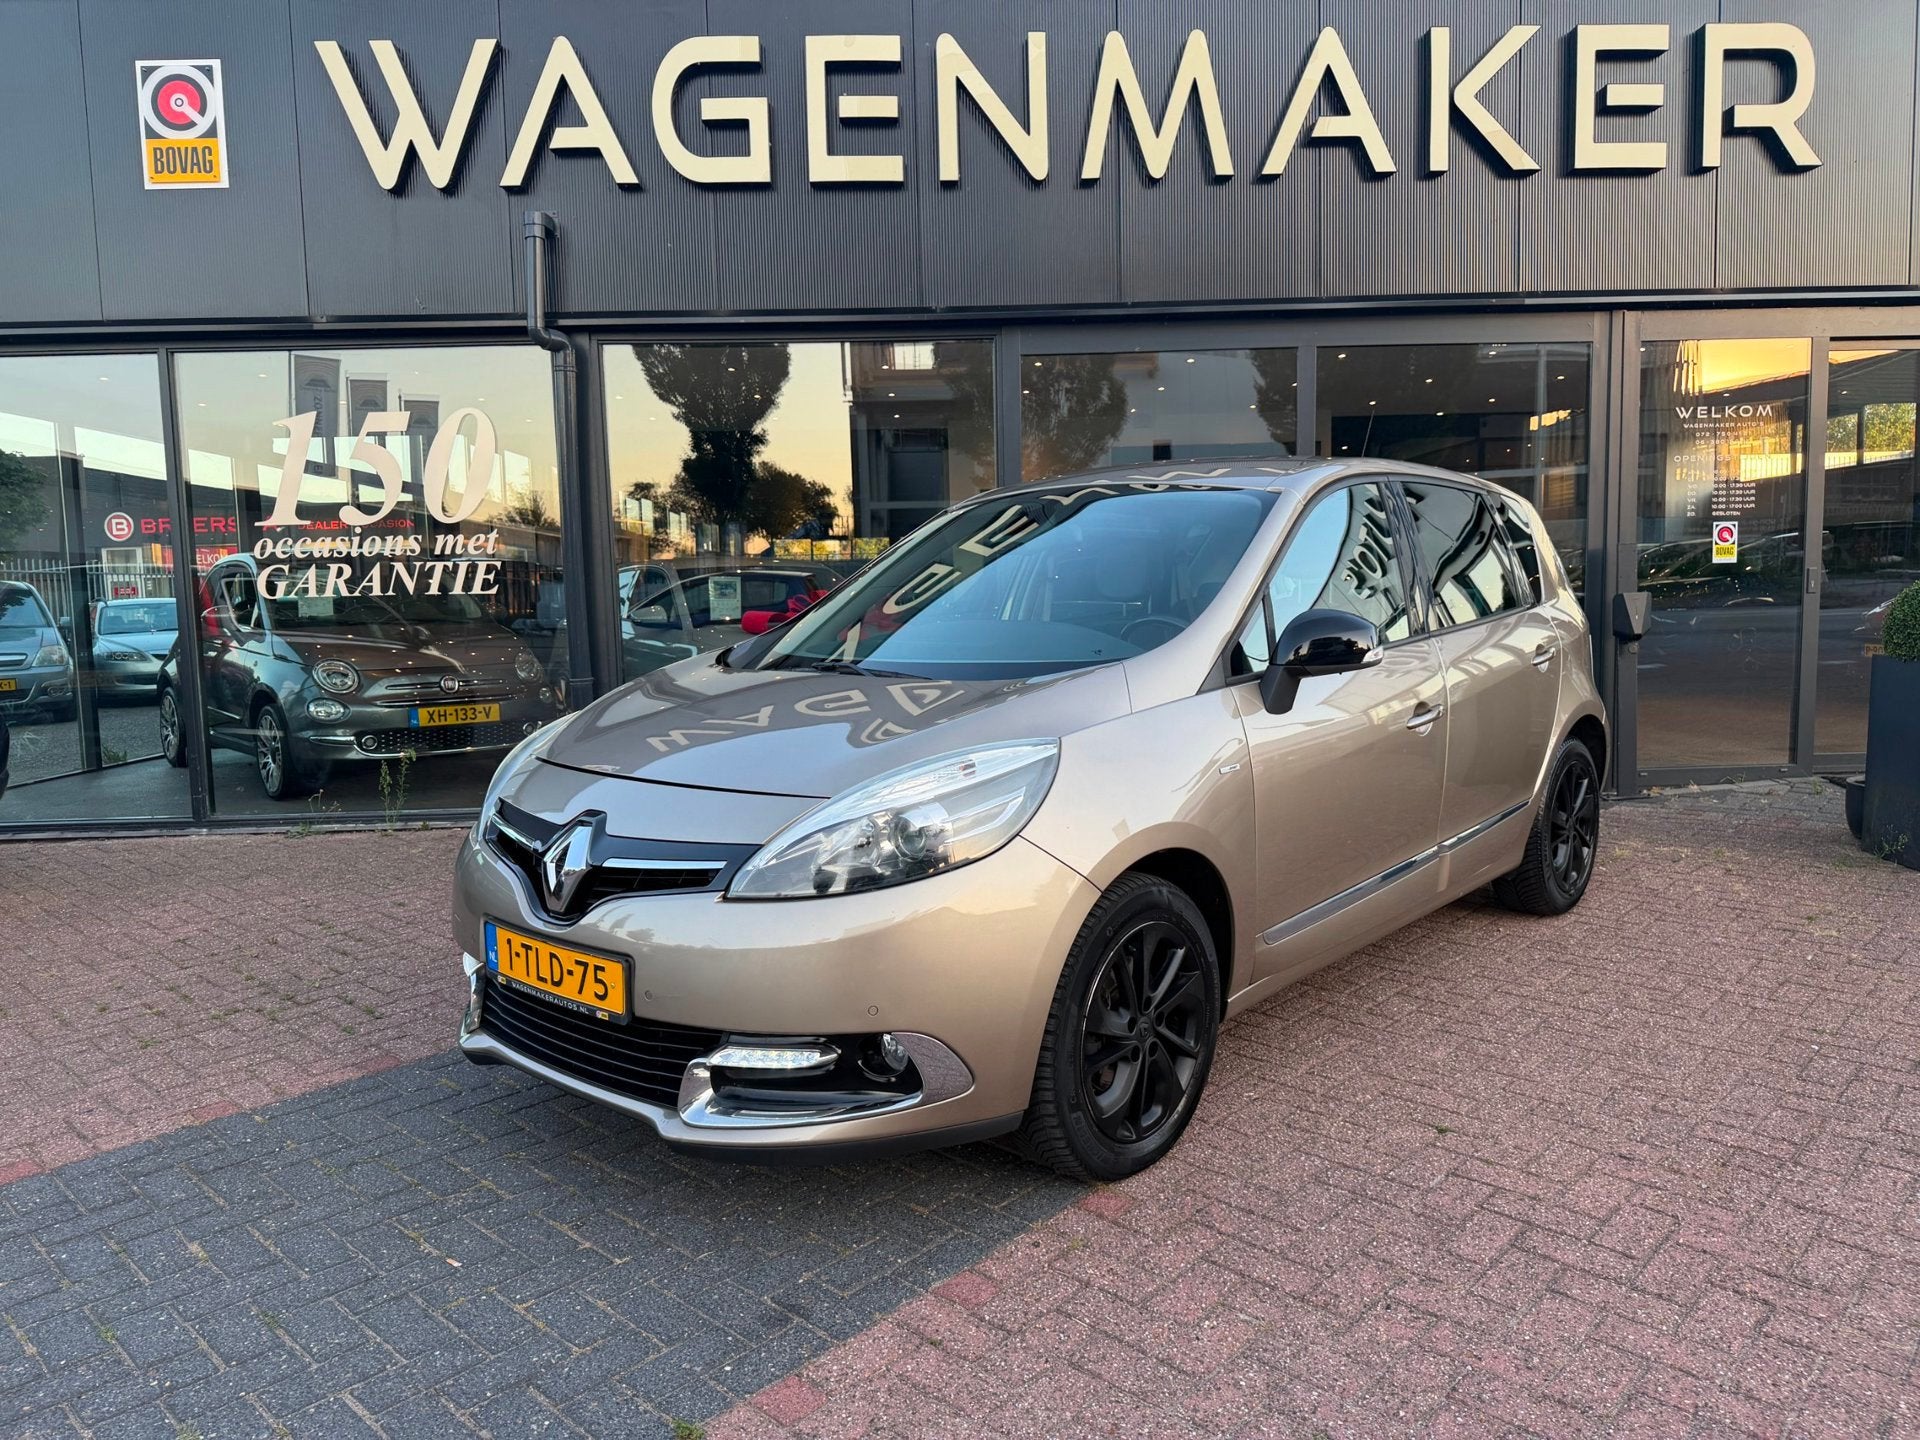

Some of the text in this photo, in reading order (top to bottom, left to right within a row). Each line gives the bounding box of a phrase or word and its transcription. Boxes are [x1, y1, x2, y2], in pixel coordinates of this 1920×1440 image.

[314, 23, 1823, 190] WAGENMAKER
[153, 146, 213, 174] BOVAG
[1676, 405, 1772, 419] WELKOM
[254, 407, 496, 526] 150
[141, 516, 237, 534] BRERS
[254, 526, 499, 559] occasions met
[1715, 546, 1735, 556] BOVAG
[256, 561, 502, 601] GARANTIE
[426, 706, 492, 724] XH-133-V
[489, 937, 609, 1001] NL 1-TLD-75
[511, 981, 590, 1015] WAGENMAKERAUTOS.NL
